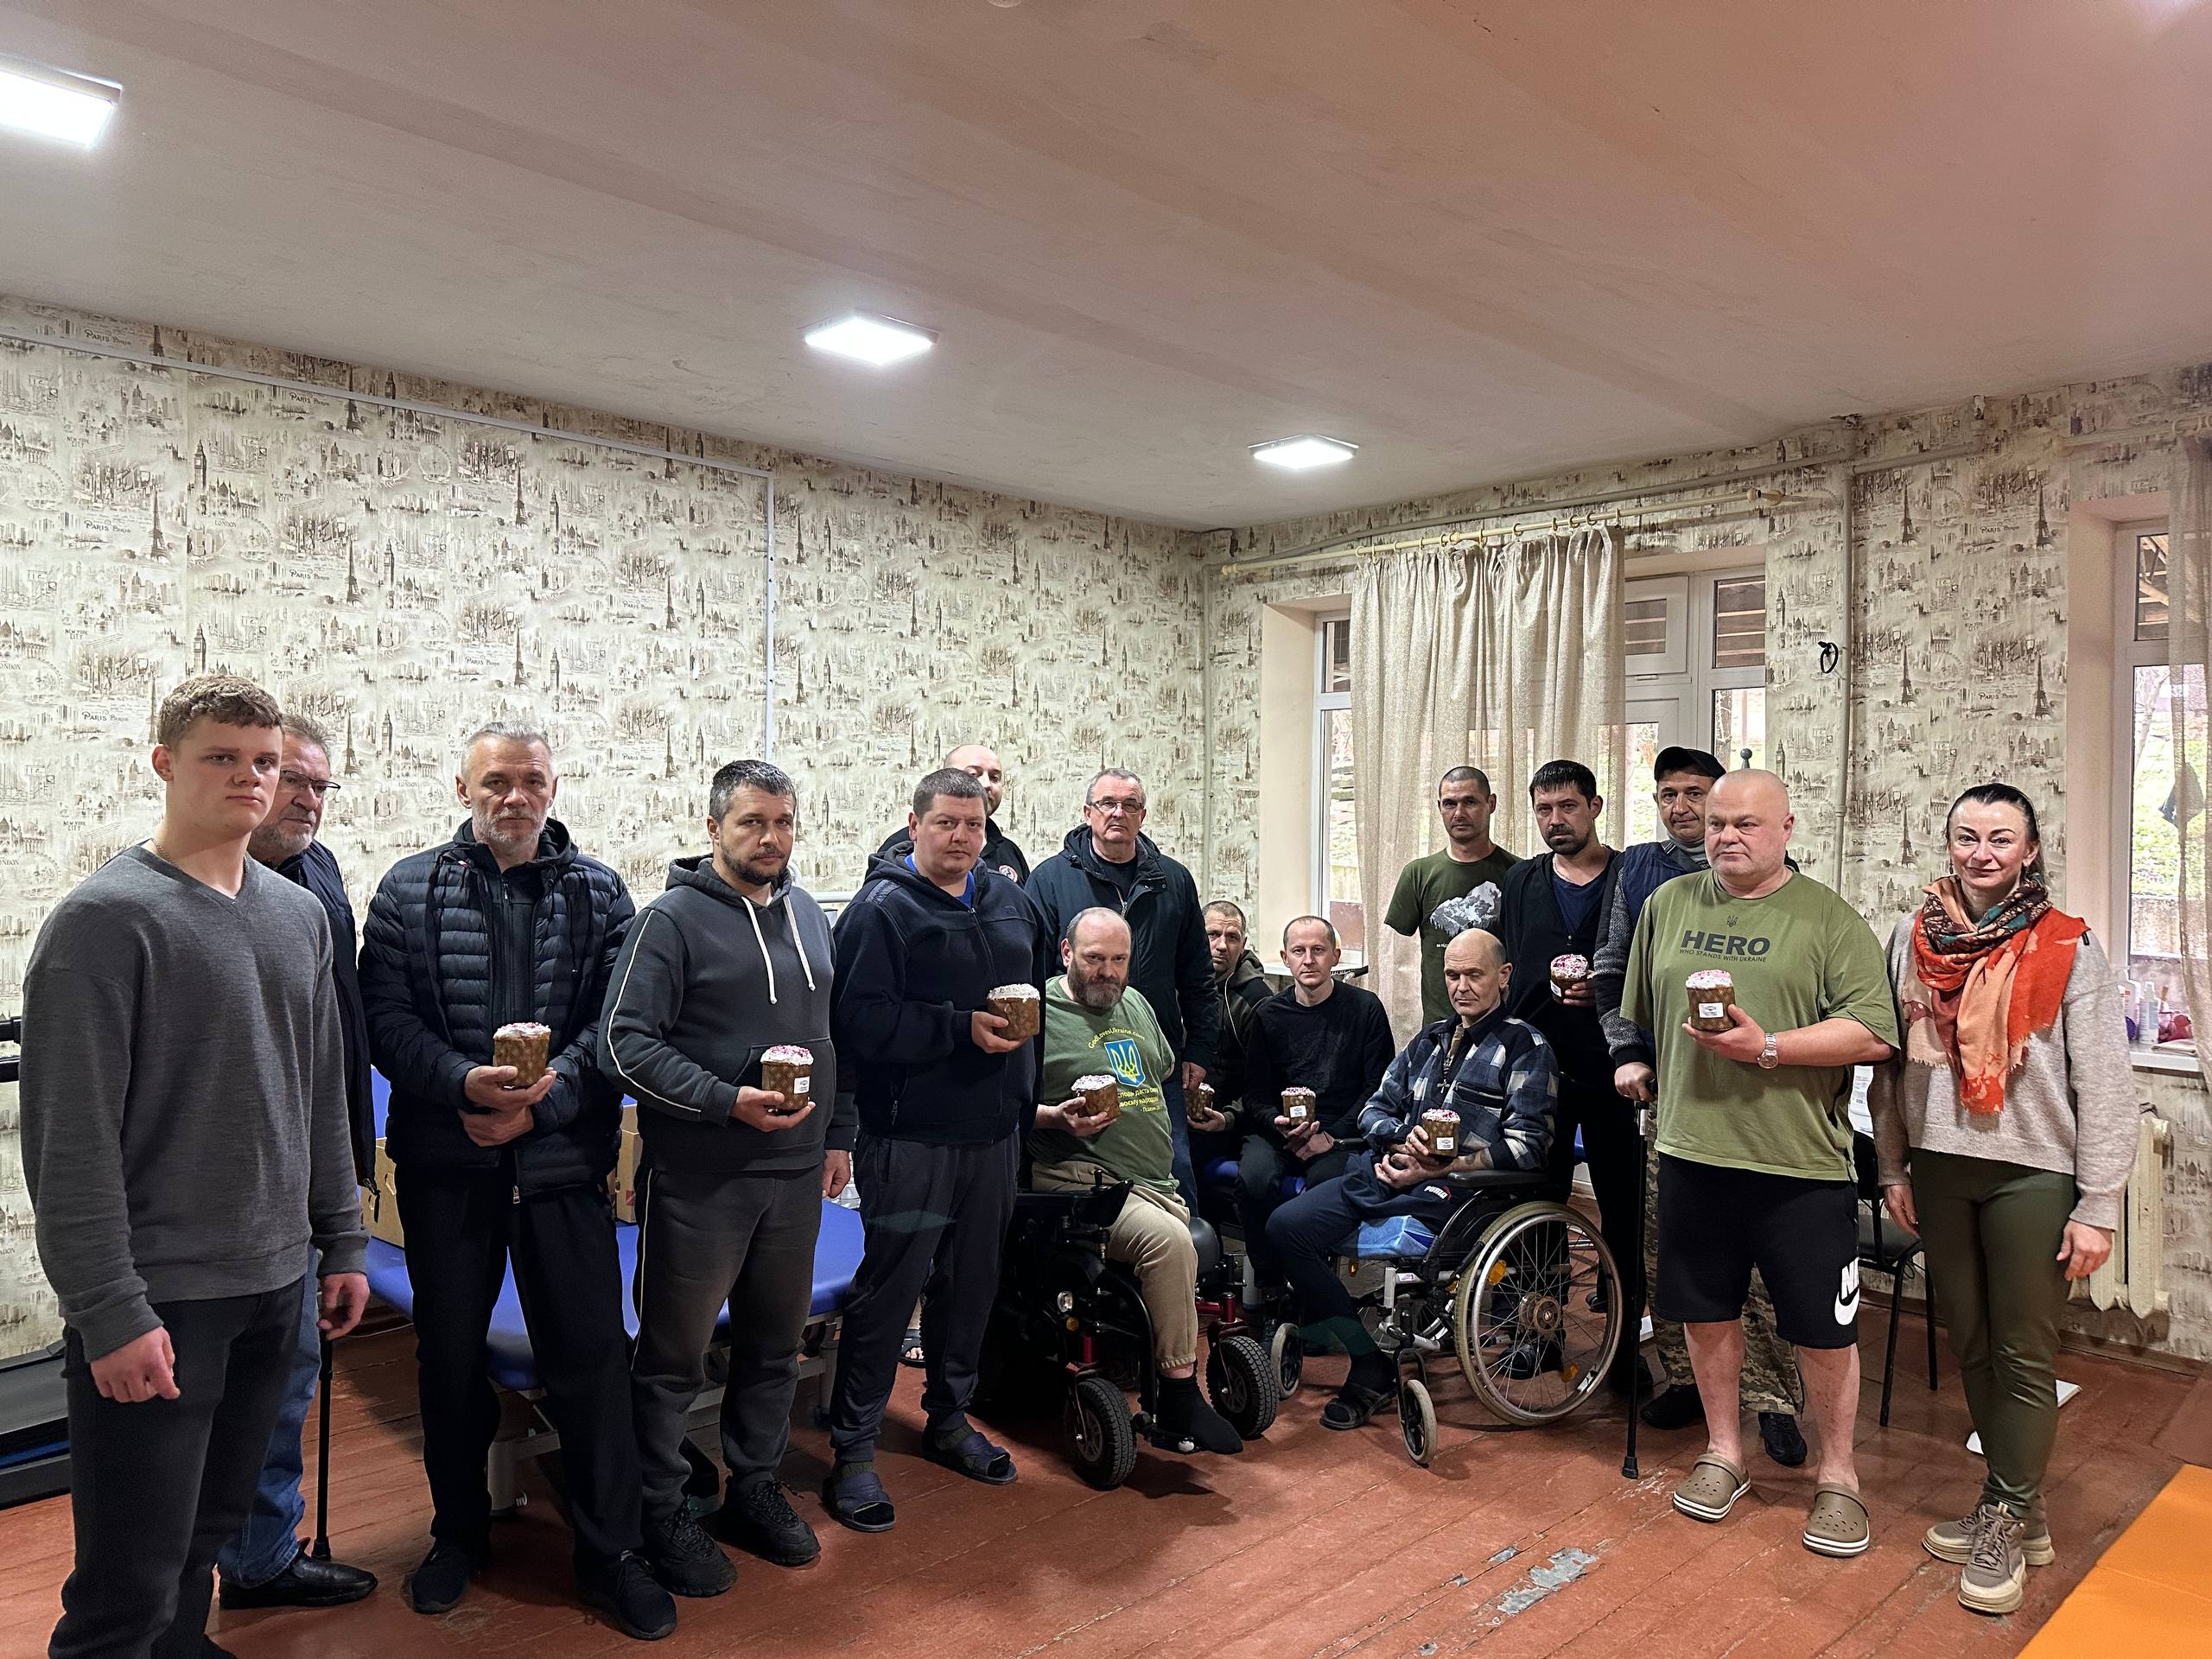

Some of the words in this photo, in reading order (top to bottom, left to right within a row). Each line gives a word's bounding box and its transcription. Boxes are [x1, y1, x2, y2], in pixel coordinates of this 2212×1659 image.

[0, 465, 22, 474] ONDON
[84, 519, 109, 531] PARIS
[0, 663, 22, 671] ONDON
[1681, 930, 1770, 956] HERO
[1695, 950, 1721, 960] STANDS
[1088, 1027, 1146, 1049] GodLovesUkraine.com
[1424, 1185, 1448, 1199] PUMA
[1841, 1256, 1859, 1300] NI
